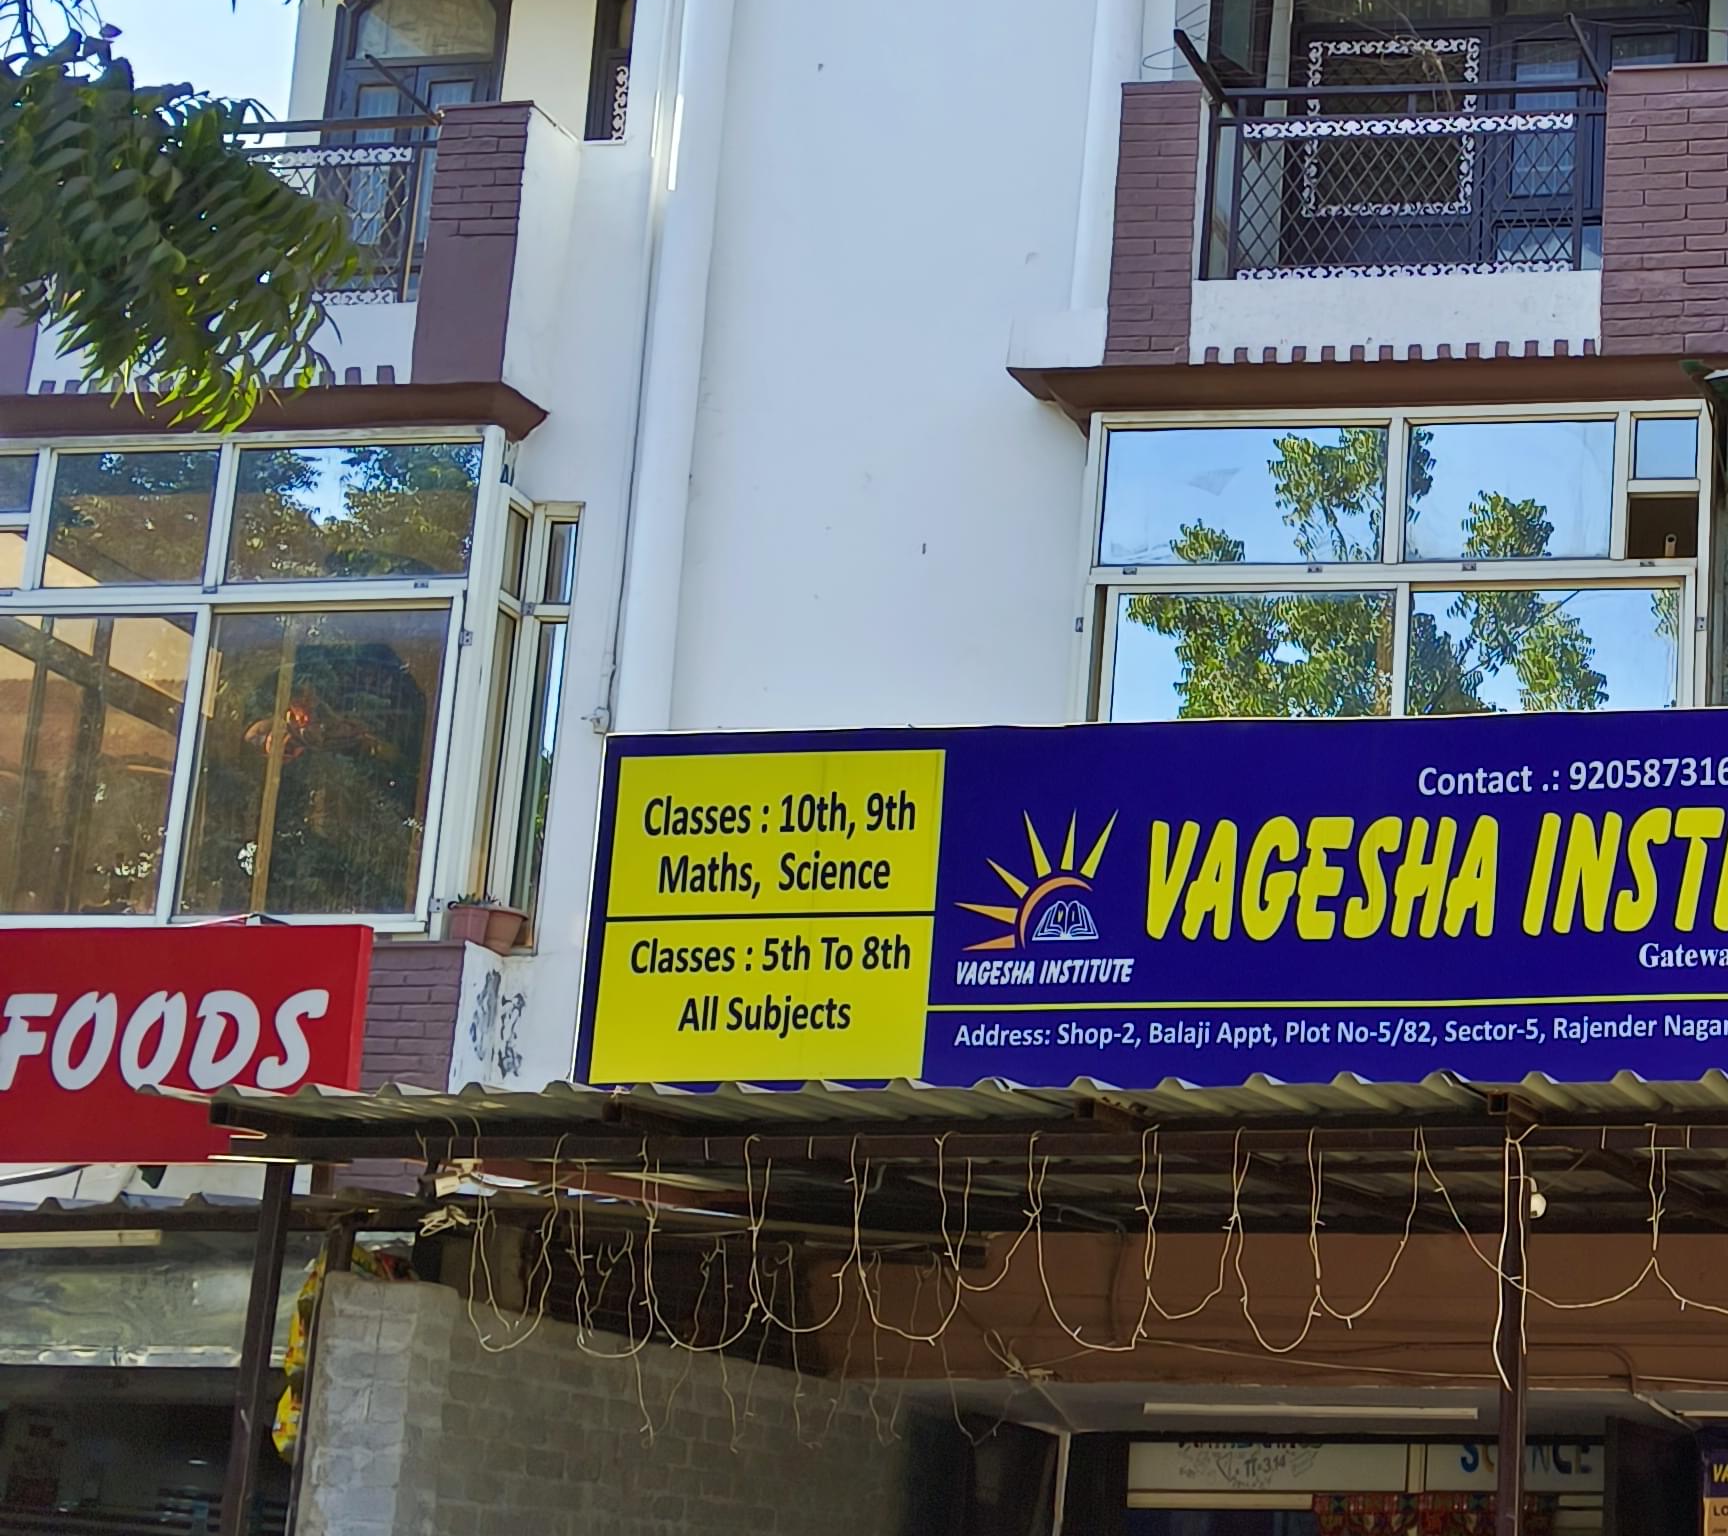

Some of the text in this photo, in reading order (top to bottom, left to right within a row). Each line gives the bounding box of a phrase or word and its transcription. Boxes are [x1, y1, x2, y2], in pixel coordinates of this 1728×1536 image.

[1418, 766, 1532, 796] Contact
[643, 792, 917, 839] Classes 10th, 9th
[658, 853, 891, 898] Maths, Science
[1146, 814, 1499, 941] VAGESHA
[630, 934, 912, 976] Classes 5th To 8th
[956, 958, 1134, 985] VAGESHA INSTITUTE
[678, 994, 852, 1038] All Subjects
[954, 1021, 1051, 1049] Address:
[1057, 1019, 1142, 1051] Shop-2,
[1148, 1018, 1210, 1050] Balaji
[1217, 1018, 1277, 1051] Appt,
[1284, 1015, 1330, 1044] Plot
[1337, 1015, 1438, 1048] No-5/82,
[1444, 1016, 1545, 1045] Sector-5,
[1552, 1014, 1657, 1045] Rajender
[0, 989, 330, 1093] FOODS
